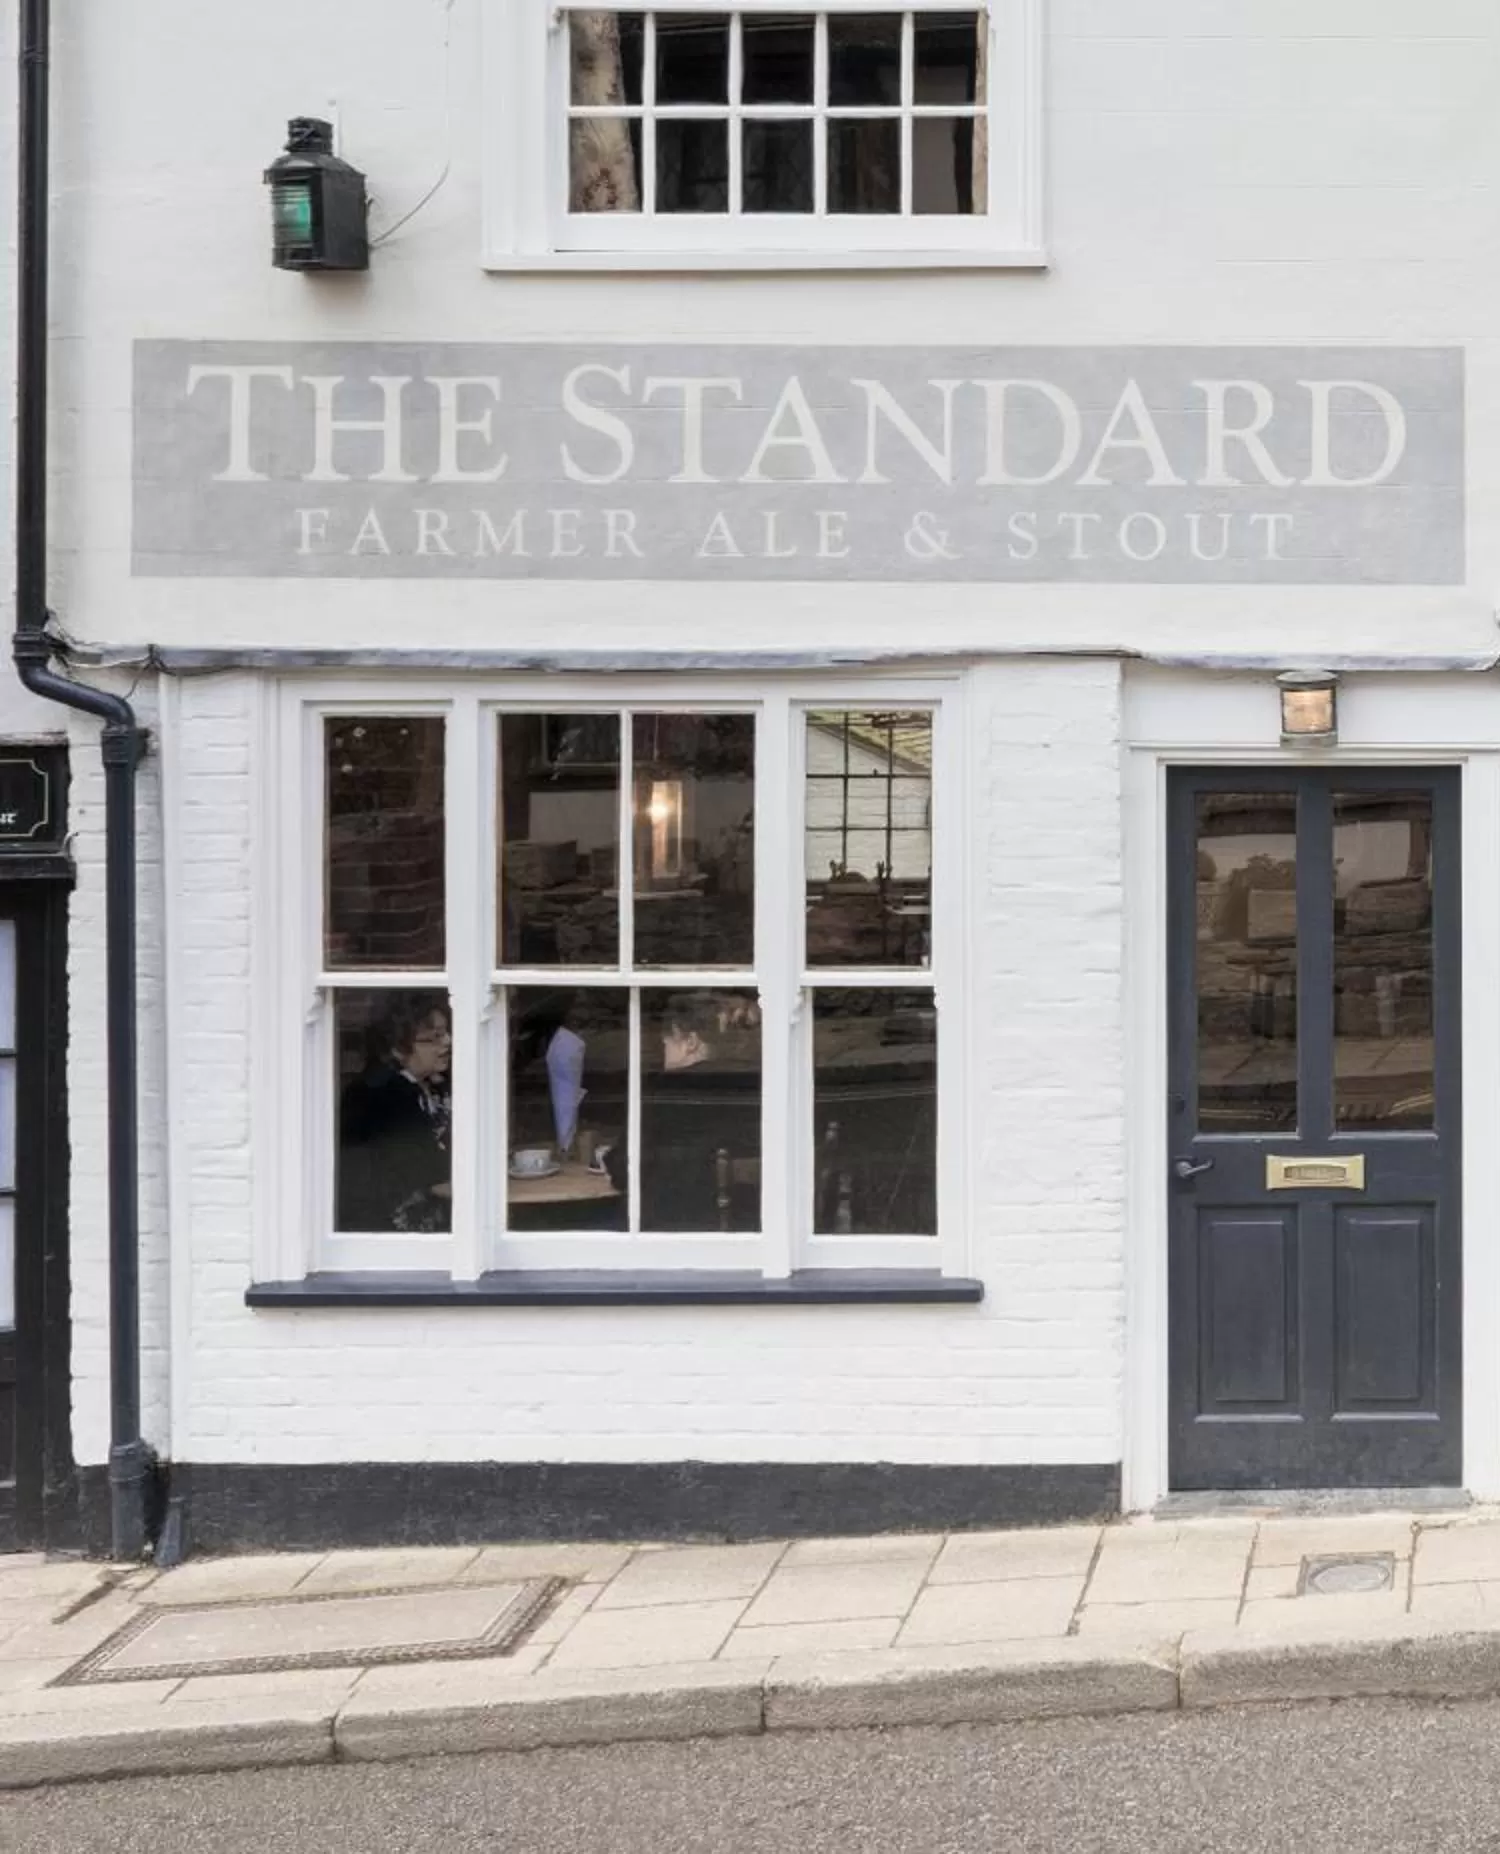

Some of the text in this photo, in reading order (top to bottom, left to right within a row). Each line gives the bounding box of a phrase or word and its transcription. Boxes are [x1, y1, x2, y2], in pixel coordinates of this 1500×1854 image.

[186, 363, 1407, 486] THE STANDARD
[295, 508, 1294, 561] FARMER ALE & STOUT
